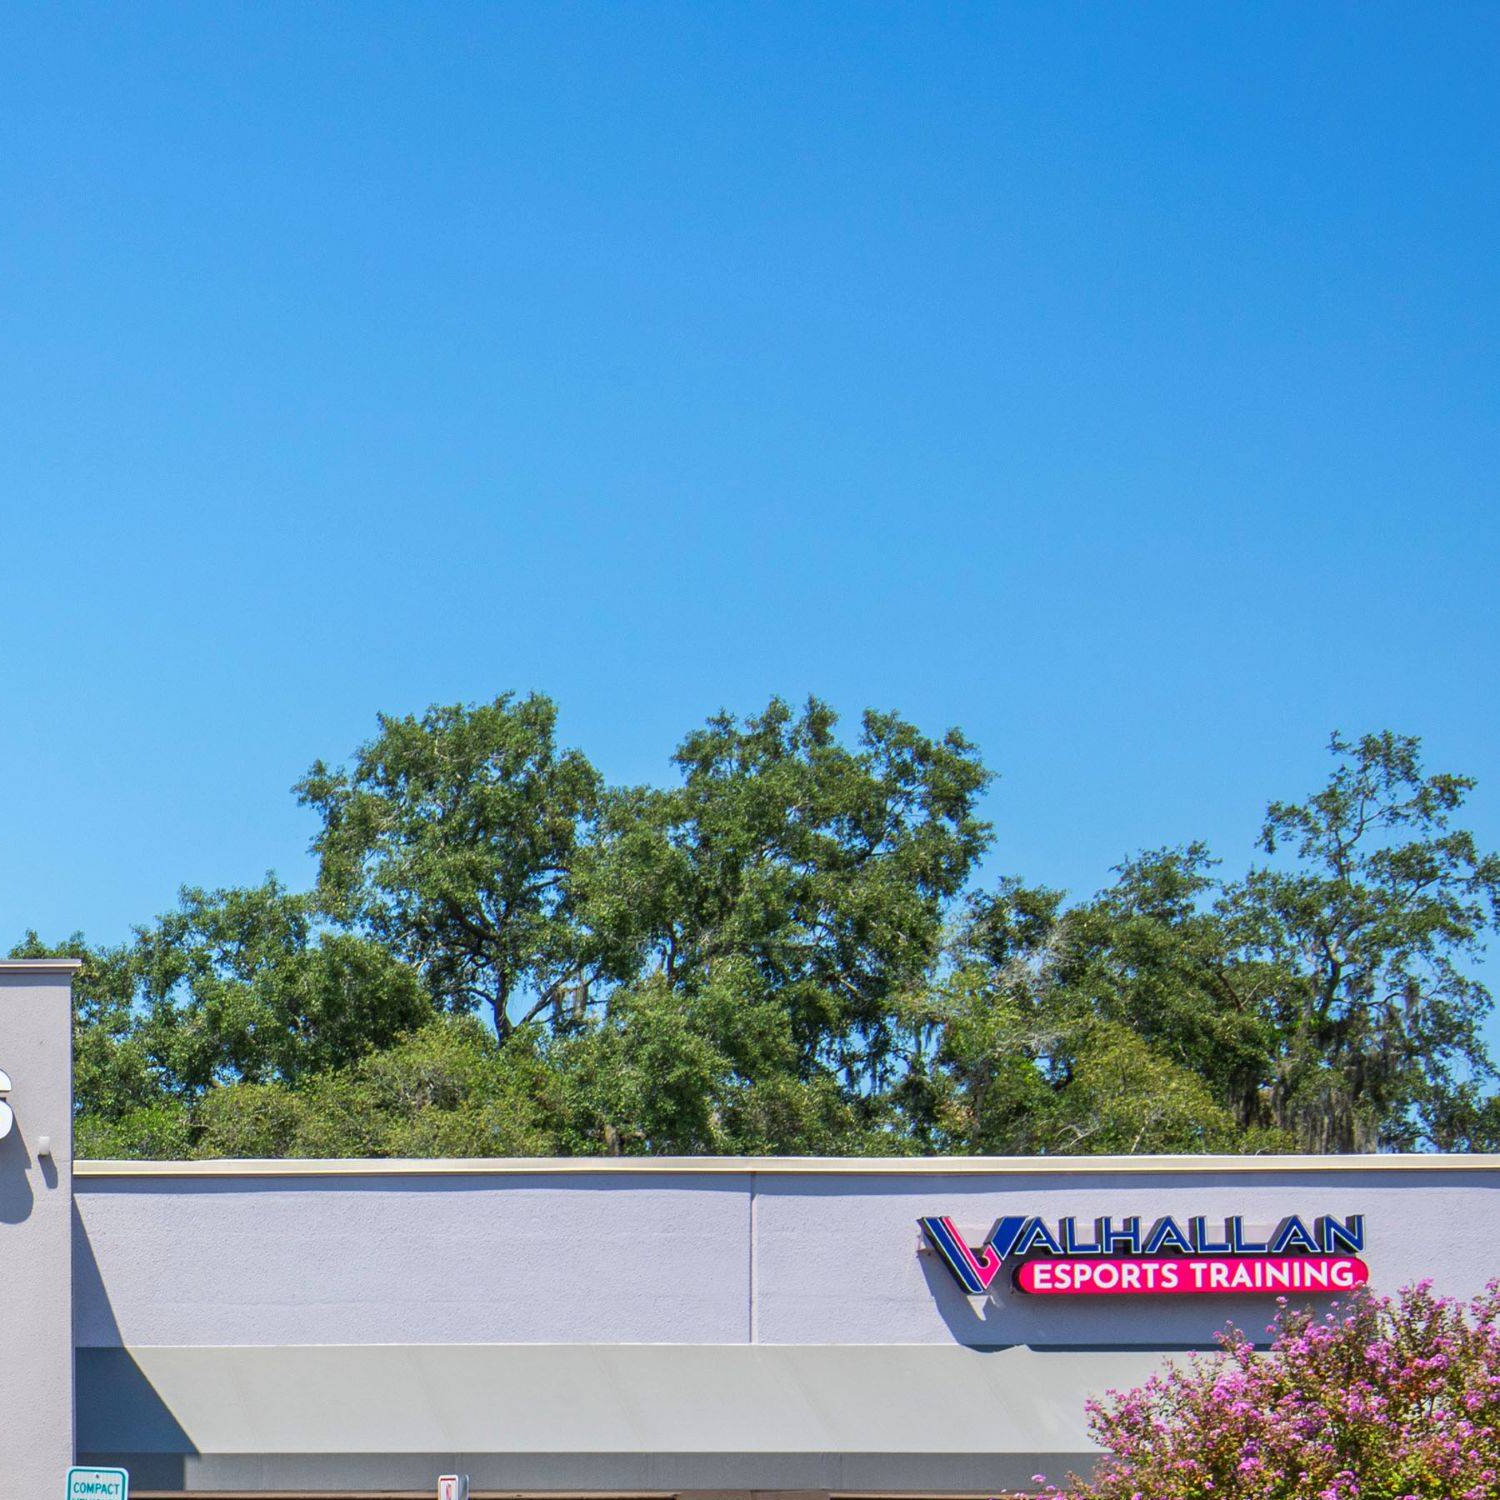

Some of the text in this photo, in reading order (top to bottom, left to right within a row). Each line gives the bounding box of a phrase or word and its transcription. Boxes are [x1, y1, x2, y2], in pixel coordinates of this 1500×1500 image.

[917, 1214, 1368, 1295] VALHALLAN
[1033, 1261, 1354, 1290] ESPORTS TRAINING
[73, 1482, 120, 1495] COMPACT
